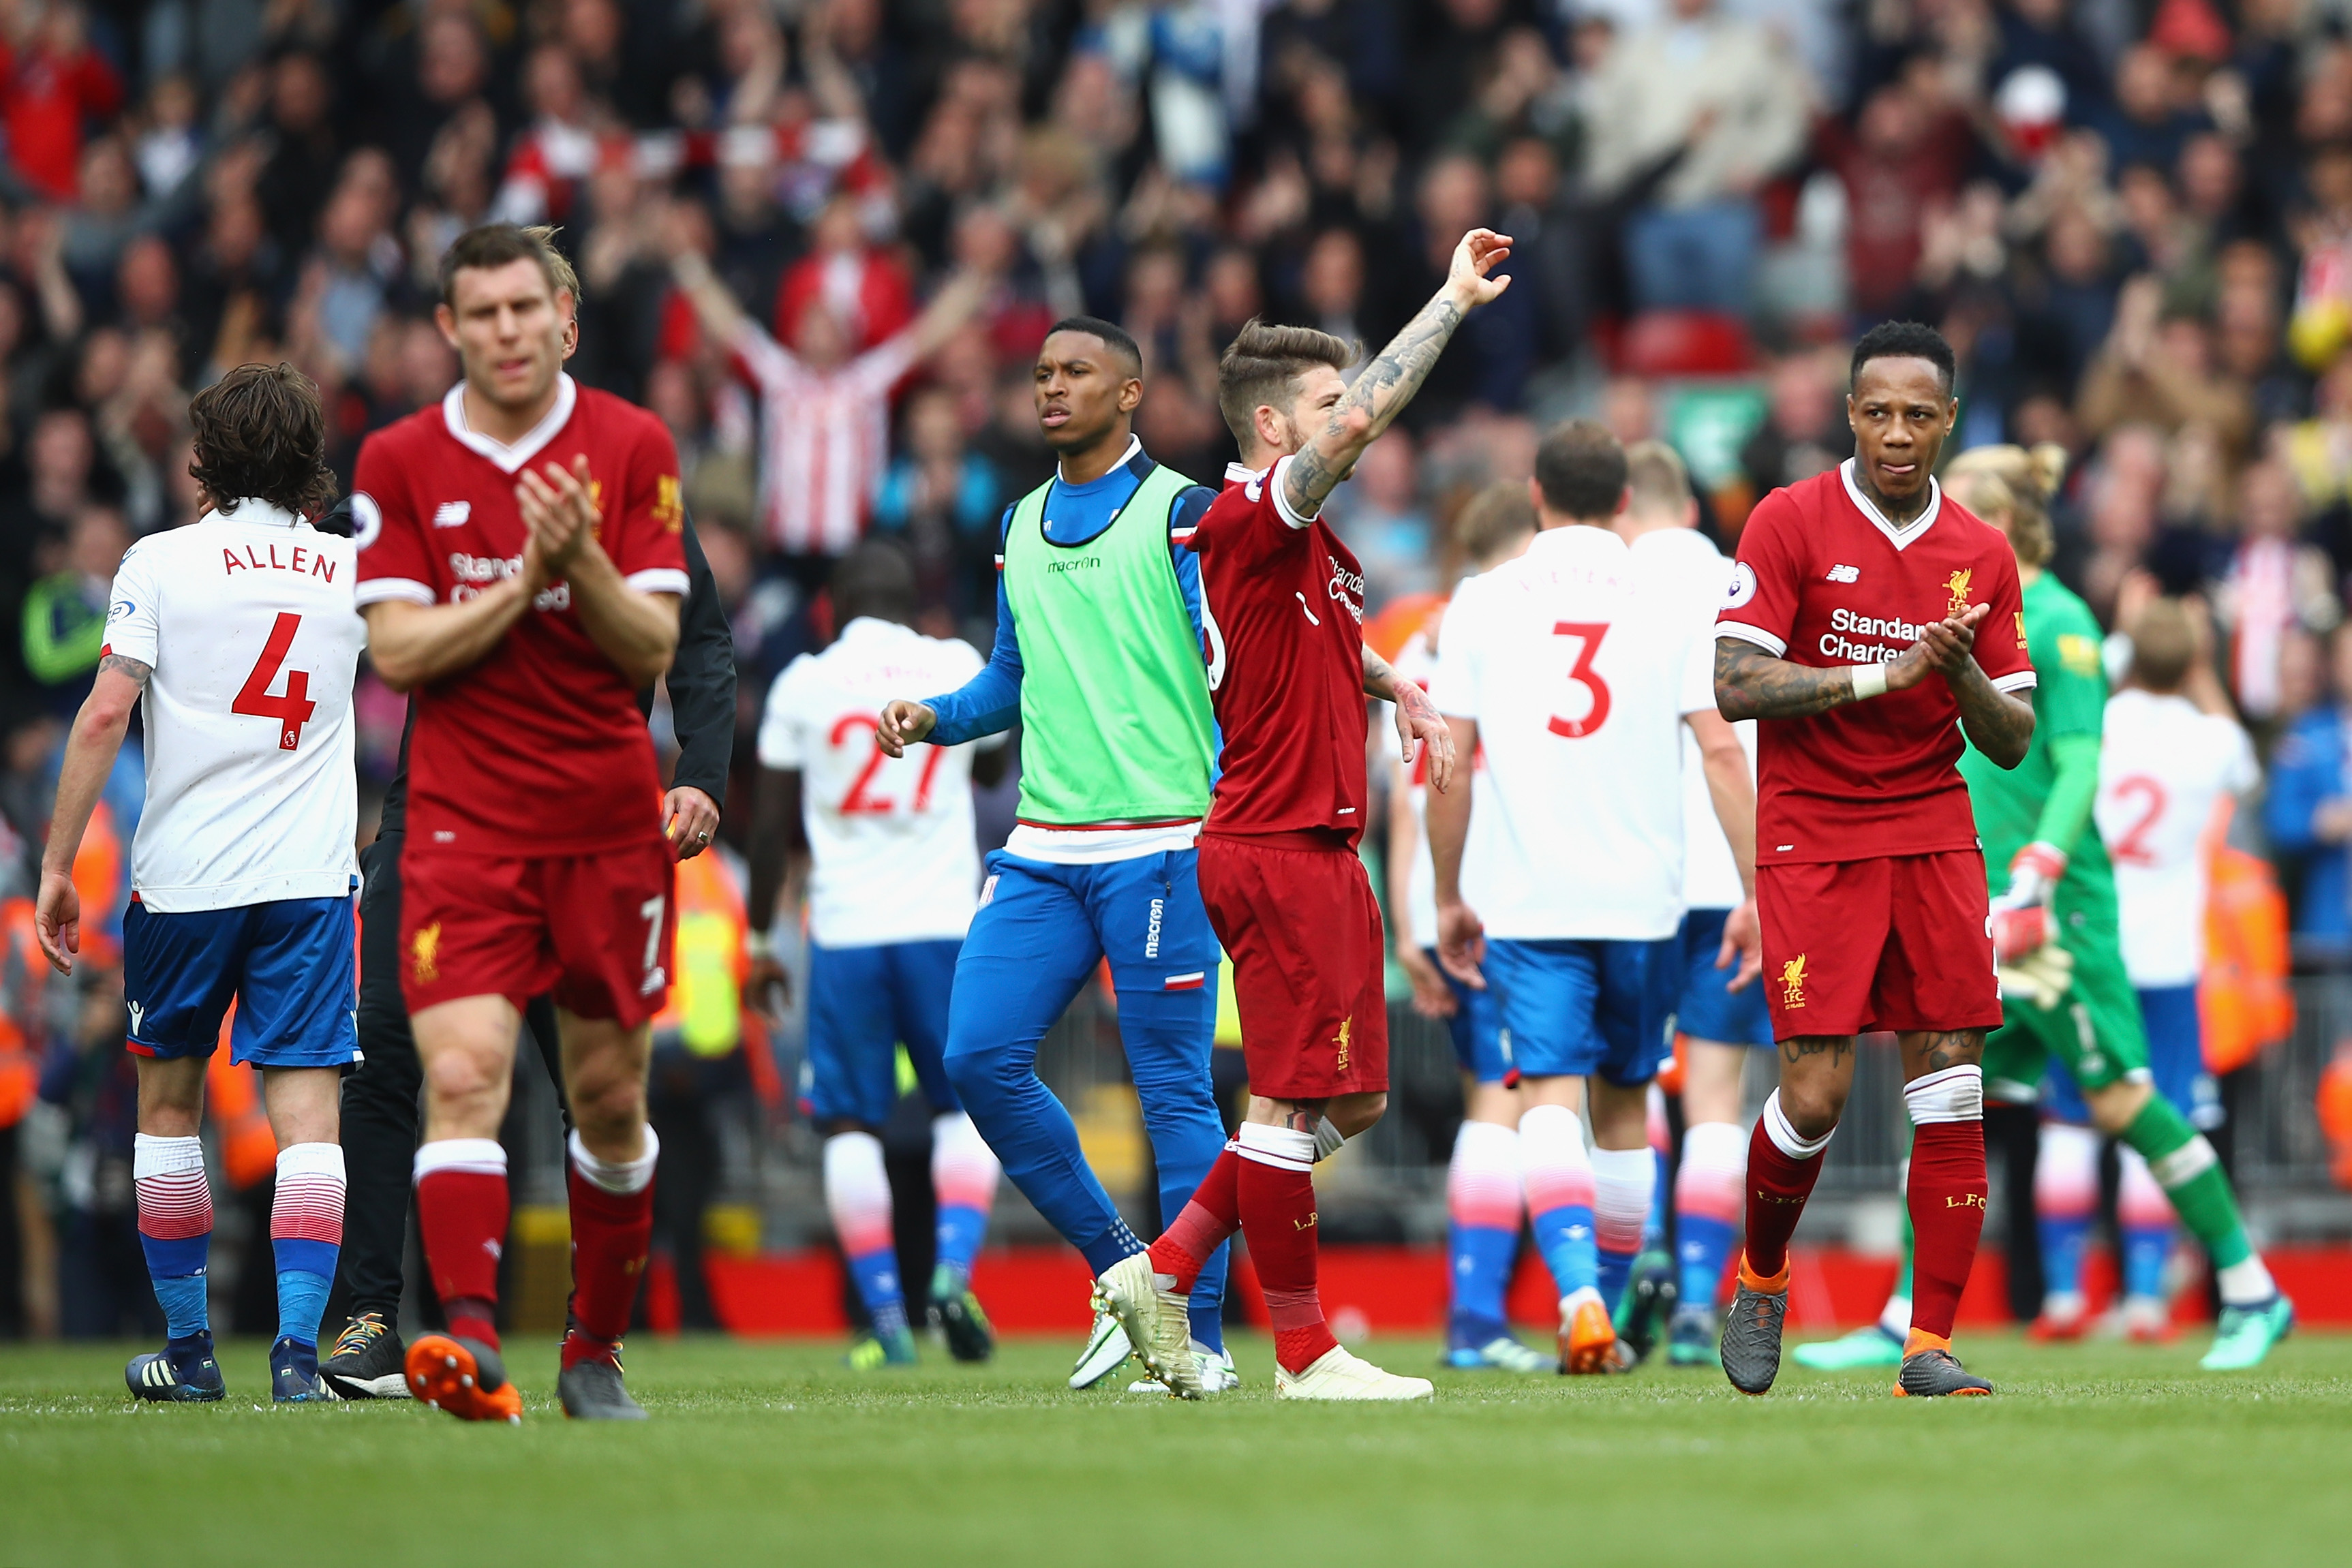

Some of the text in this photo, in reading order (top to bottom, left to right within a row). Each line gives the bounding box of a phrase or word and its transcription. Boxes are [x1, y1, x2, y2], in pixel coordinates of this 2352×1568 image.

[222, 543, 337, 583] ALLEN
[448, 552, 523, 583] Stand
[1819, 633, 1904, 664] Charte
[1831, 608, 1926, 641] Standar
[230, 611, 318, 752] 4
[1547, 620, 1612, 739] 3
[2111, 773, 2169, 868] 2
[641, 893, 666, 971] 7
[1145, 898, 1163, 958] macron
